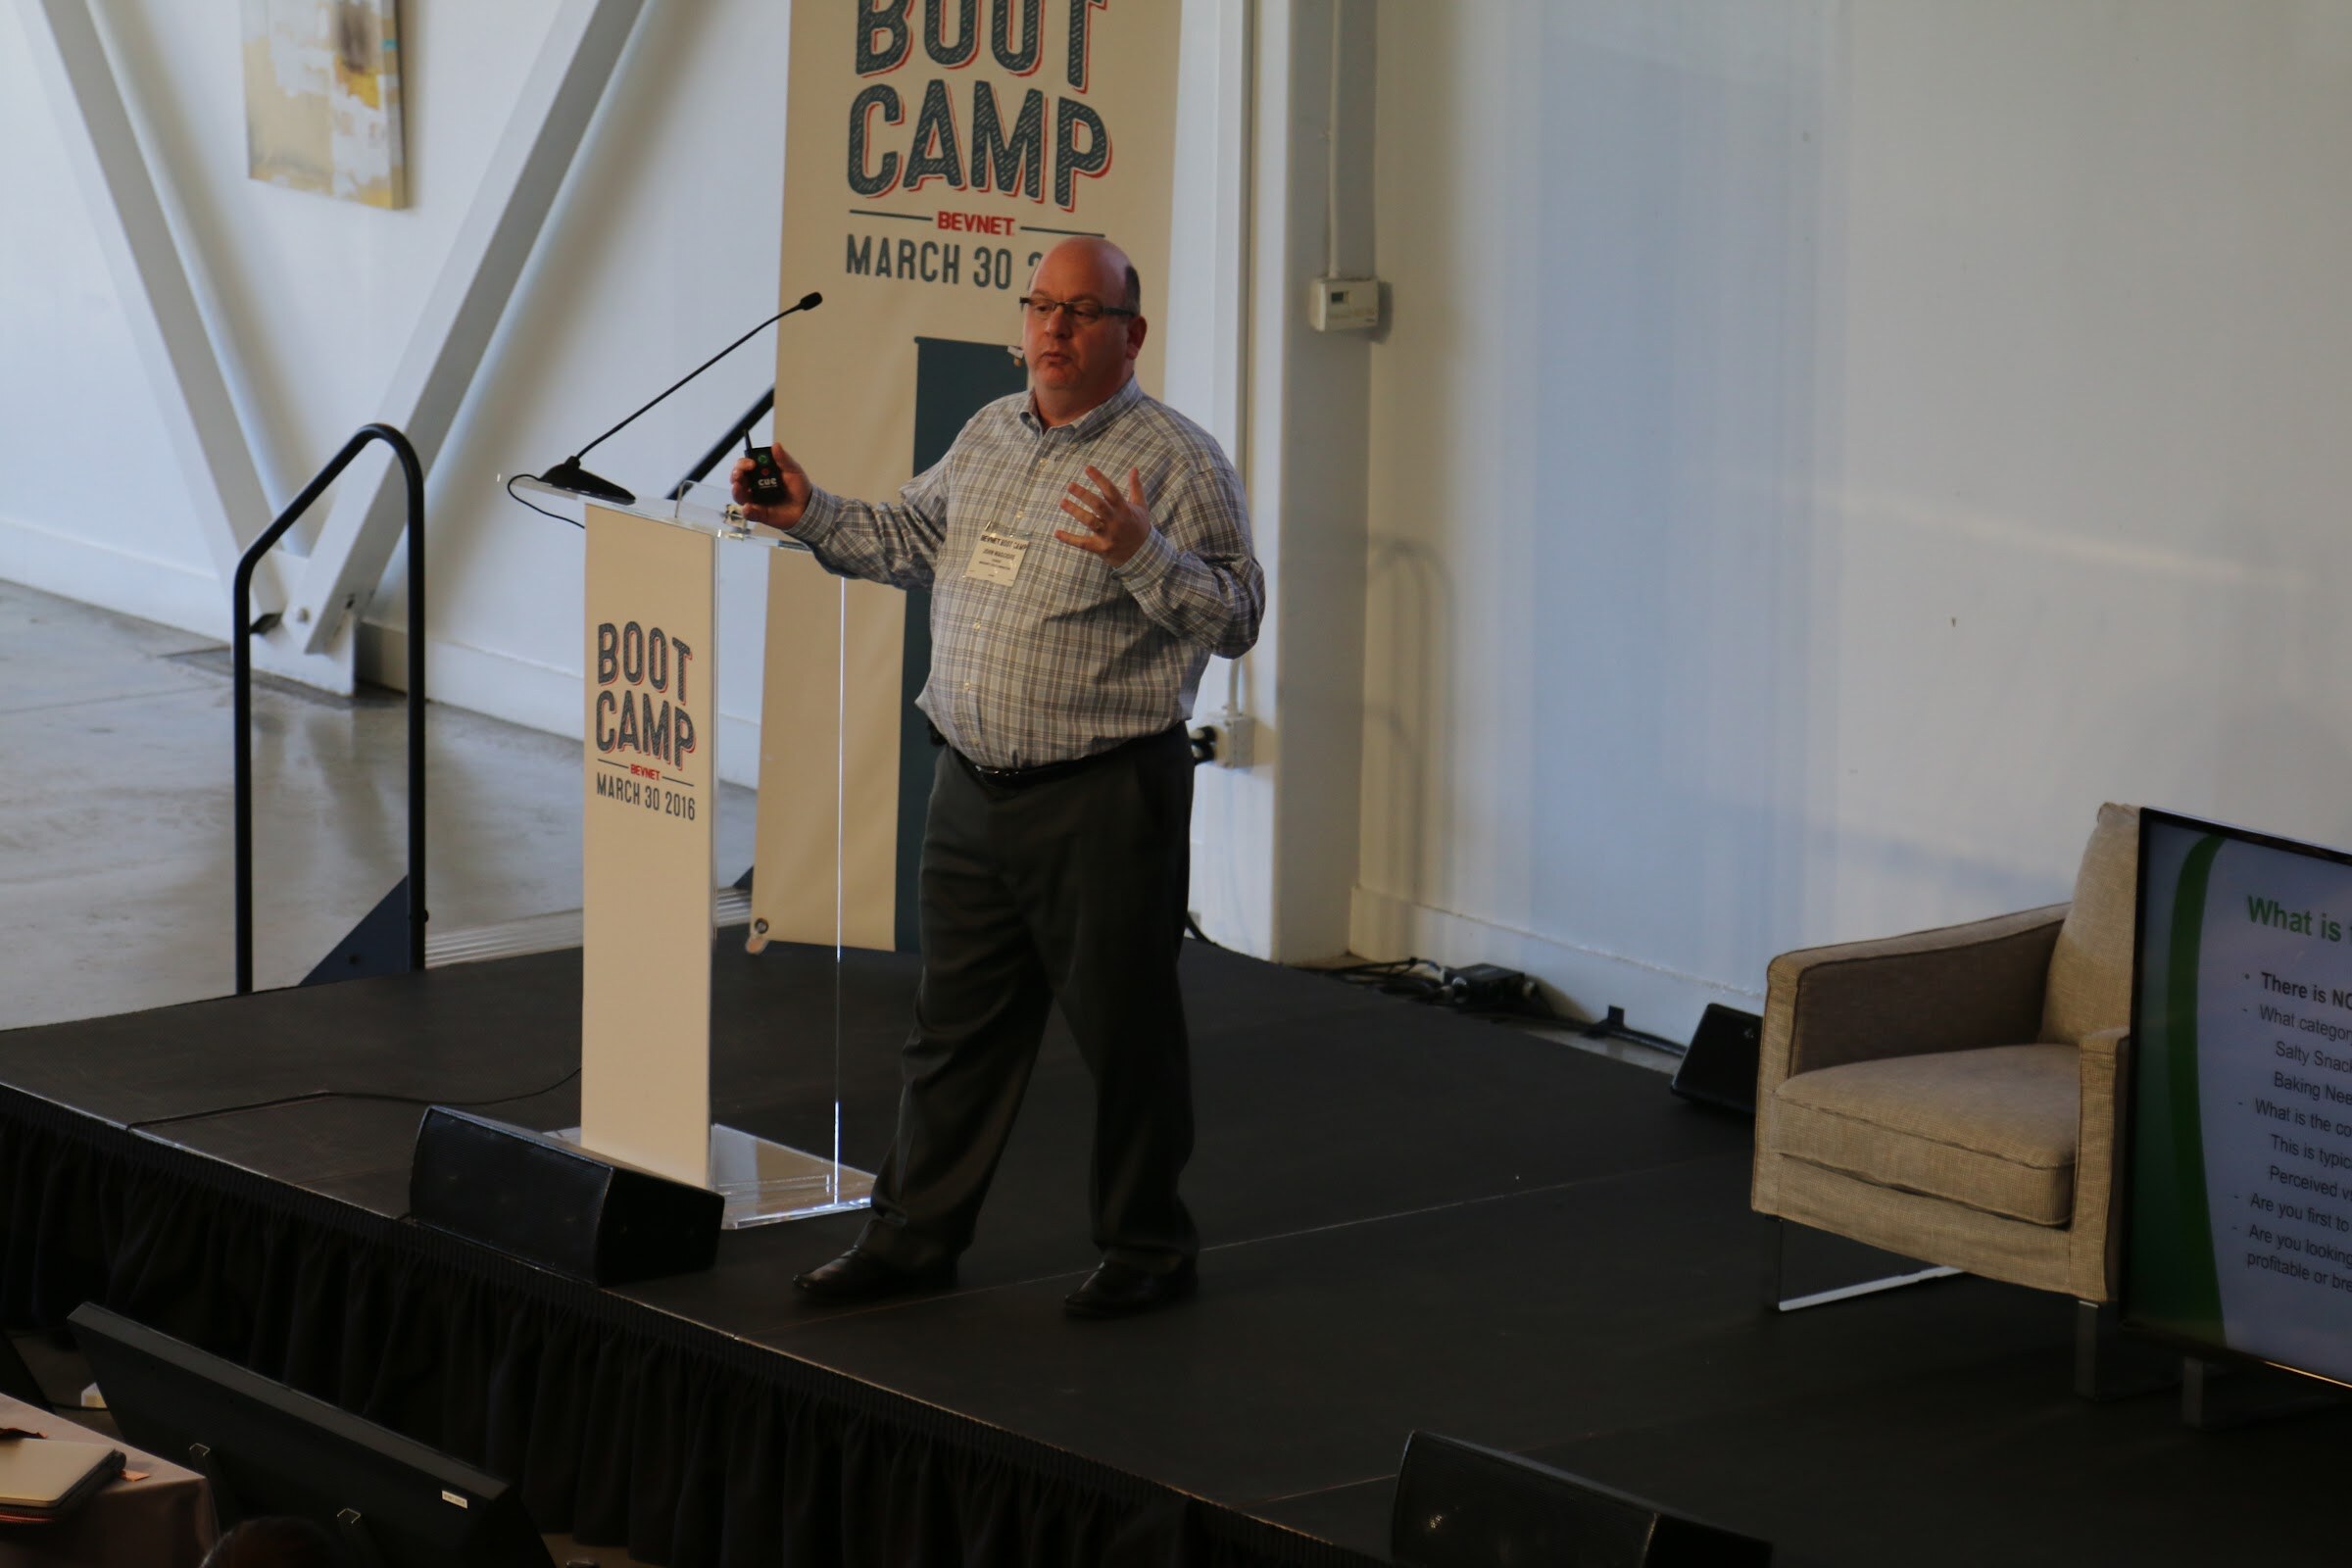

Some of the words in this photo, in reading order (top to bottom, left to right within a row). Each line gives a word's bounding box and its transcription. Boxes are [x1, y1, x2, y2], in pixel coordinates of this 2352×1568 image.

[856, 0, 1107, 93] BOOT
[848, 79, 1113, 213] CAMP
[937, 211, 1015, 236] BEVNET
[846, 233, 960, 285] MARCH
[973, 246, 1012, 290] 30
[597, 620, 693, 706] BOOT
[596, 689, 697, 771] CAMP
[630, 763, 661, 781] BEVNET
[596, 771, 640, 806] MARCH
[645, 785, 660, 811] 30
[665, 791, 696, 821] 2016
[2247, 895, 2313, 937] What
[2321, 912, 2342, 943] is
[2261, 971, 2308, 999] There
[2313, 984, 2328, 1004] is
[2259, 1004, 2295, 1028] What
[2299, 1017, 2352, 1042] categor
[2276, 1040, 2310, 1067] Salty
[2274, 1070, 2321, 1102] Baking
[2255, 1098, 2291, 1122] What
[2295, 1108, 2307, 1126] is
[2311, 1113, 2331, 1132] the
[2270, 1133, 2300, 1156] This
[2304, 1142, 2315, 1160] is
[2320, 1147, 2352, 1169] typic
[2269, 1164, 2338, 1198] Perceived
[2250, 1192, 2275, 1212] Are
[2278, 1202, 2303, 1220] you
[2307, 1206, 2332, 1230] first
[2336, 1215, 2350, 1233] to
[2249, 1222, 2274, 1244] Are
[2277, 1233, 2302, 1251] you
[2306, 1238, 2352, 1271] looking
[2246, 1253, 2311, 1281] profitable
[2314, 1271, 2329, 1286] or
